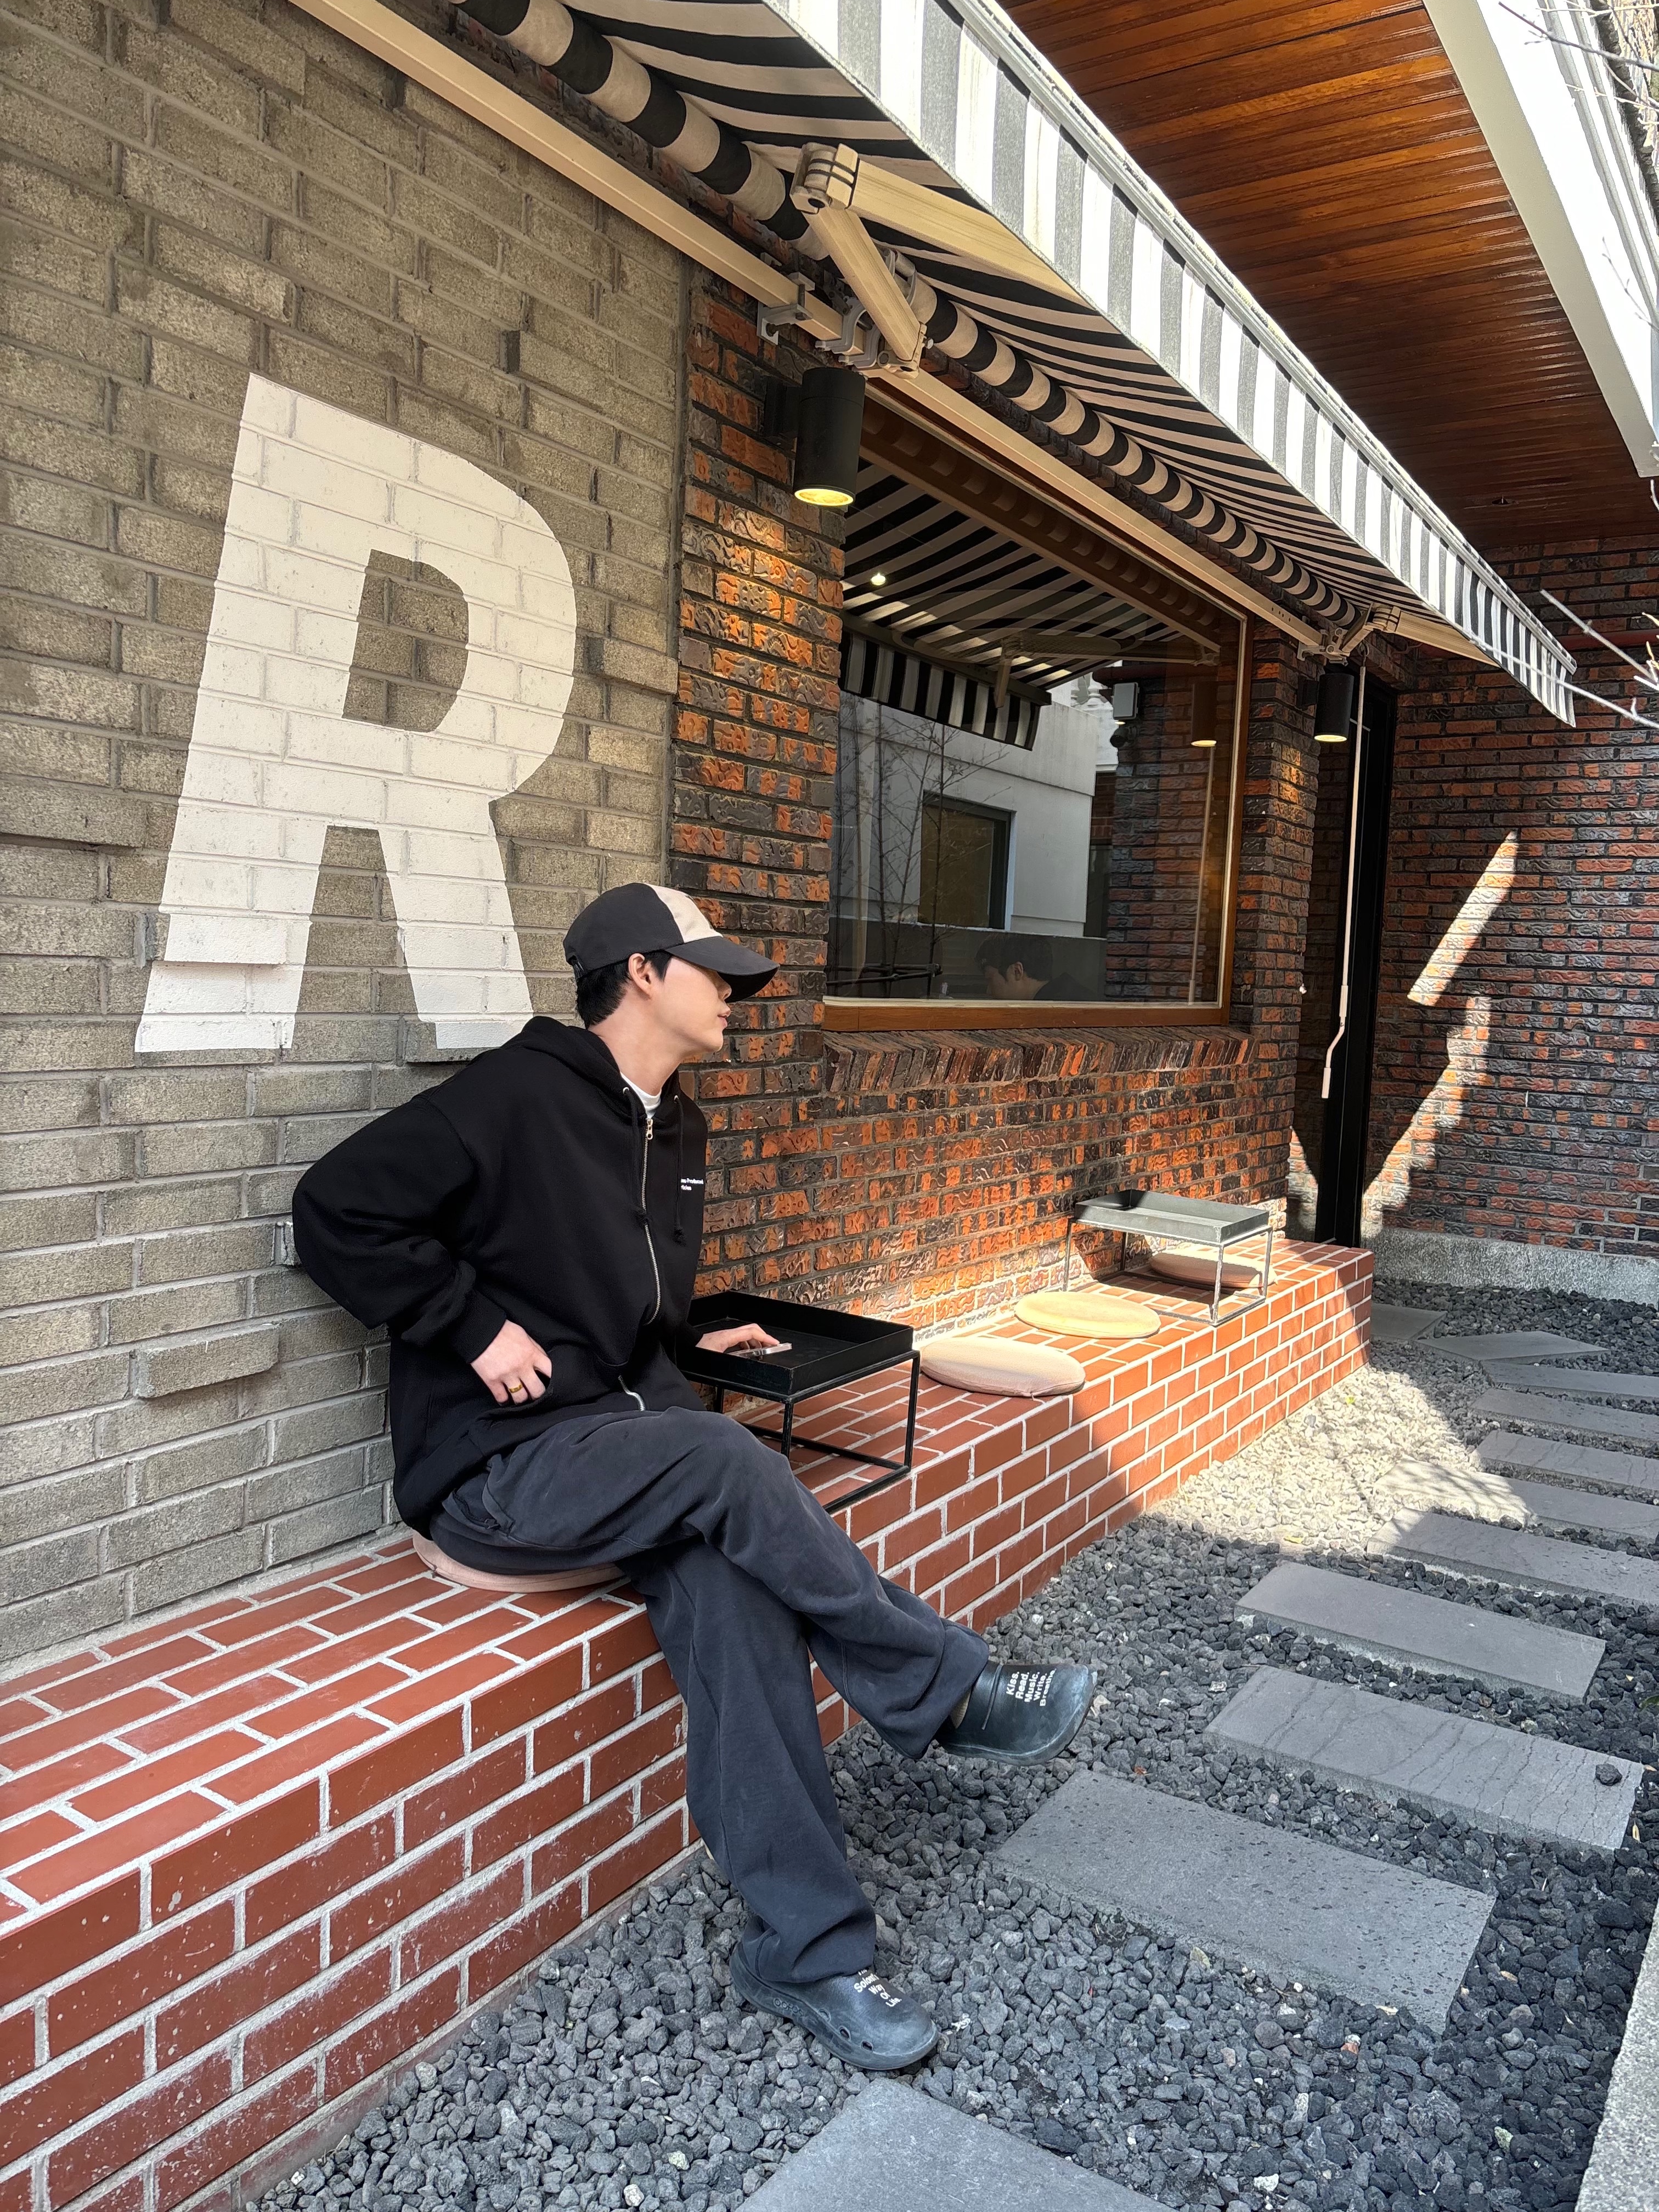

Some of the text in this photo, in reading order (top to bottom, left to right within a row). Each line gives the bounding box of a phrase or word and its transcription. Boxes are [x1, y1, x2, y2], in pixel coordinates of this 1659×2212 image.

[135, 372, 576, 1052] R
[1015, 1672, 1029, 1699] Read.
[1024, 1671, 1040, 1702] Music.
[868, 1984, 885, 1994] Way
